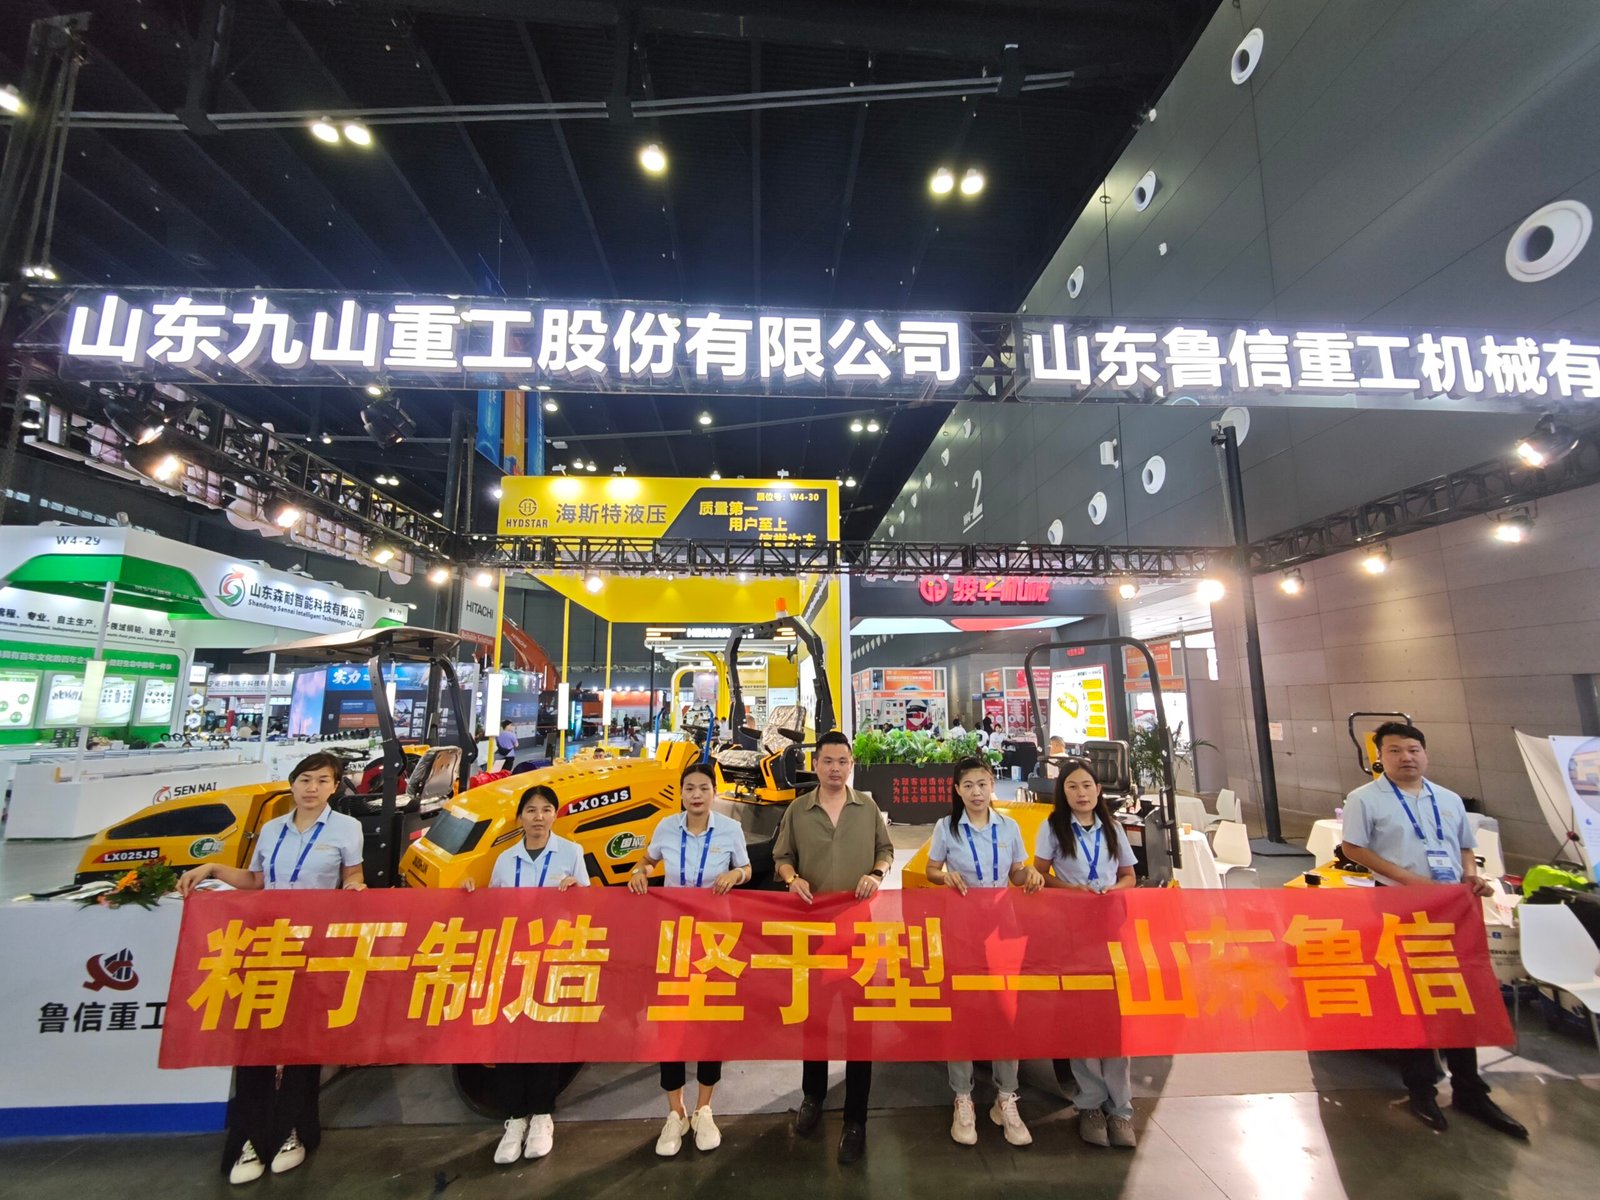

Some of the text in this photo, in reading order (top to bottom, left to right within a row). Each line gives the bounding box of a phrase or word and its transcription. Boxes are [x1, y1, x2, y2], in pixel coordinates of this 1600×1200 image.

[67, 295, 963, 384] 山东九山重工股份有限公司
[1029, 324, 1600, 398] 山东鲁信重工机械有
[789, 492, 820, 502] W4-30
[556, 502, 667, 525] 海斯特液压
[699, 500, 759, 517] 质量第一
[506, 518, 548, 529] HYDSTAR
[728, 516, 788, 533] 用户至上
[56, 535, 101, 547] W4-29
[249, 582, 366, 622] 山东森耐智能科技有限公司
[465, 600, 494, 619] HITACHI
[248, 598, 277, 613] Shandong
[277, 605, 296, 615] Sennai
[296, 609, 322, 621] Intelligent
[321, 614, 347, 626] Technology
[333, 668, 362, 686] 实力
[174, 781, 217, 797] SEN NAI
[568, 789, 630, 815] LX03JS
[104, 850, 159, 863] LX025JS
[187, 914, 610, 1031] 精于制造
[38, 1001, 168, 1034] 鲁信重工
